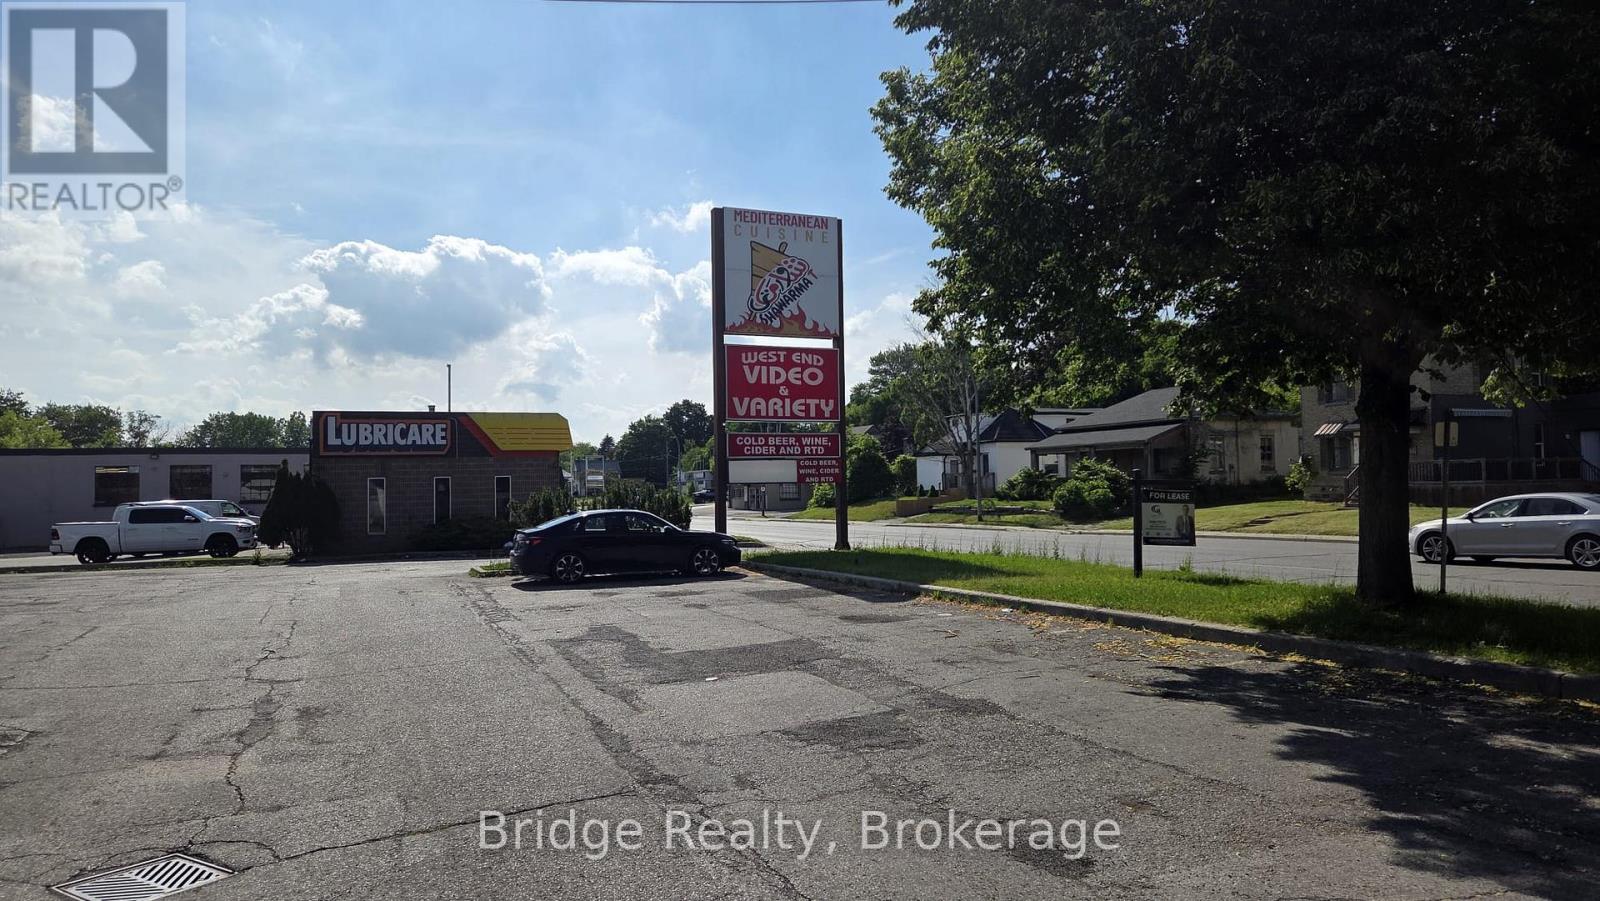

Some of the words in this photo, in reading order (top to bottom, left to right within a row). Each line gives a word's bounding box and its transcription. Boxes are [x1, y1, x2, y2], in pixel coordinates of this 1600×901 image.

[734, 209, 828, 230] MEDITERRANEAN
[734, 223, 828, 244] CUISINE
[759, 278, 814, 325] SHAWARMA
[741, 351, 787, 364] WEST
[791, 352, 824, 366] END
[743, 365, 824, 386] VIDEO
[779, 385, 789, 396] &
[732, 397, 834, 418] VARIETY
[326, 416, 447, 446] LUBRICARE
[736, 436, 765, 446] COLD
[768, 436, 799, 446] BEER,
[801, 436, 831, 447] WINE,
[744, 446, 776, 455] CIDER
[779, 446, 801, 455] AND
[804, 446, 824, 455] RTD
[1150, 491, 1166, 500] FOR
[1167, 492, 1190, 500] LEASE
